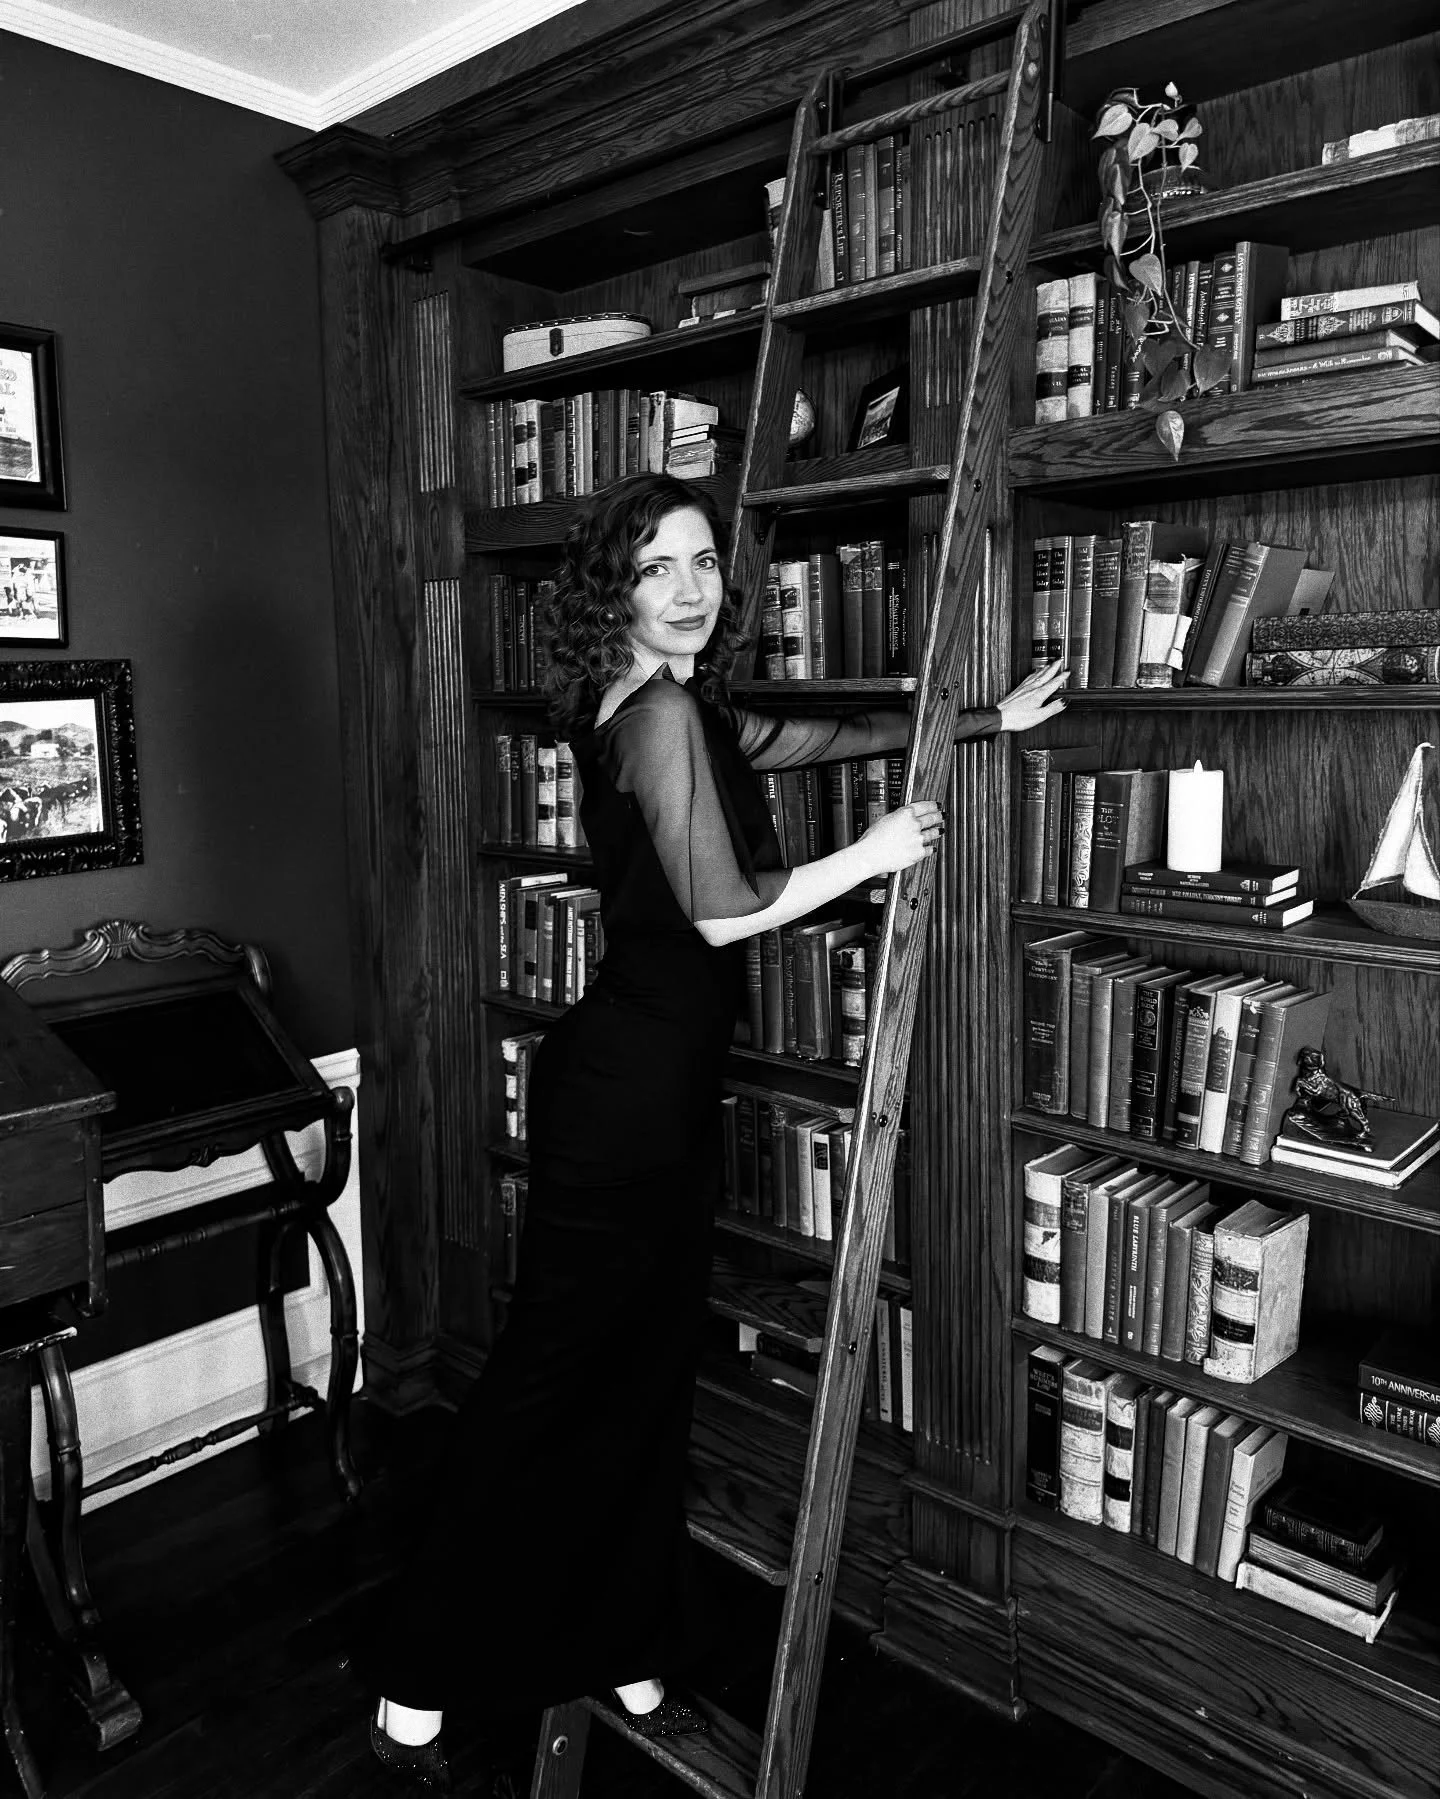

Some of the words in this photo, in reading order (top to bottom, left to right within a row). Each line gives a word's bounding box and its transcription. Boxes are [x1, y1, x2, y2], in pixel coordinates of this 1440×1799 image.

[836, 236, 846, 257] LIFE
[1131, 1234, 1139, 1272] LABYRINTH
[1388, 1380, 1440, 1404] ANNIVERSAR
